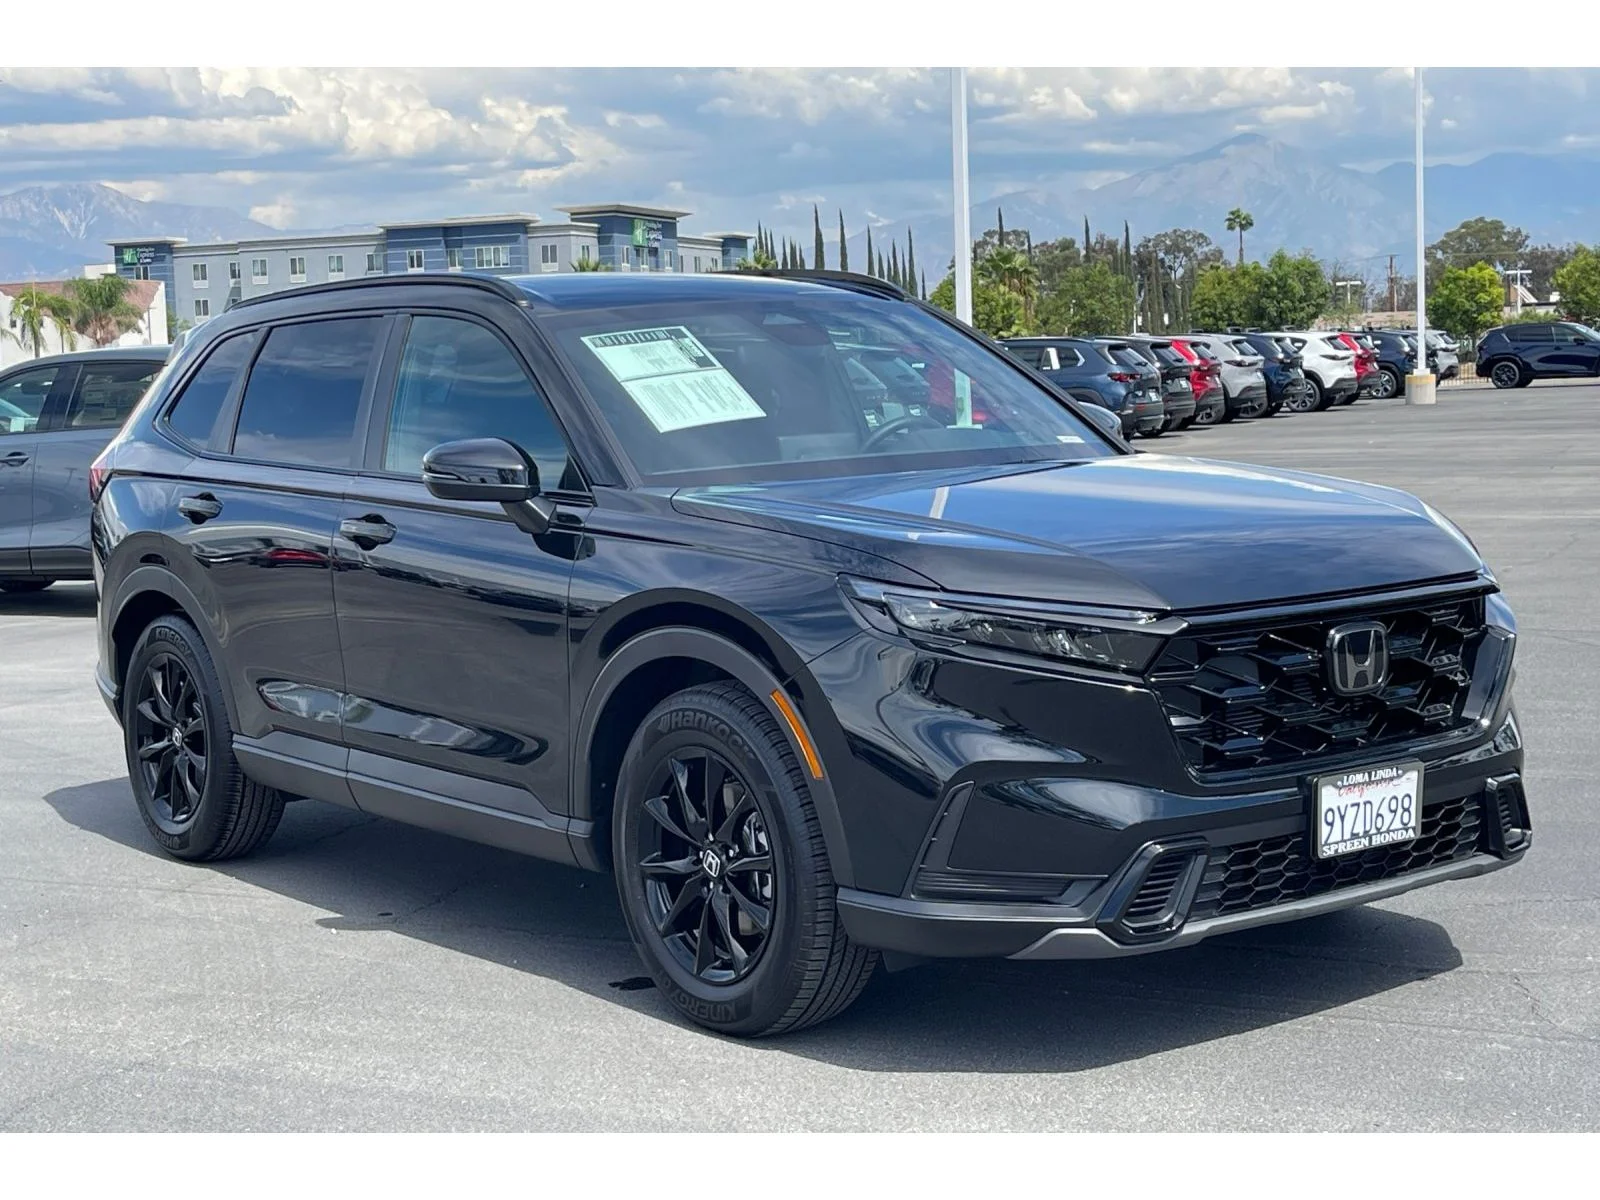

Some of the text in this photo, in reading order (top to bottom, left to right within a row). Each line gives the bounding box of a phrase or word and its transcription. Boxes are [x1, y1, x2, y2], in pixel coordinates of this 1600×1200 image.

[1343, 767, 1398, 786] LOMA LINDA
[1323, 793, 1413, 845] 9YZD698
[1322, 828, 1415, 856] SPREEN HONDA
